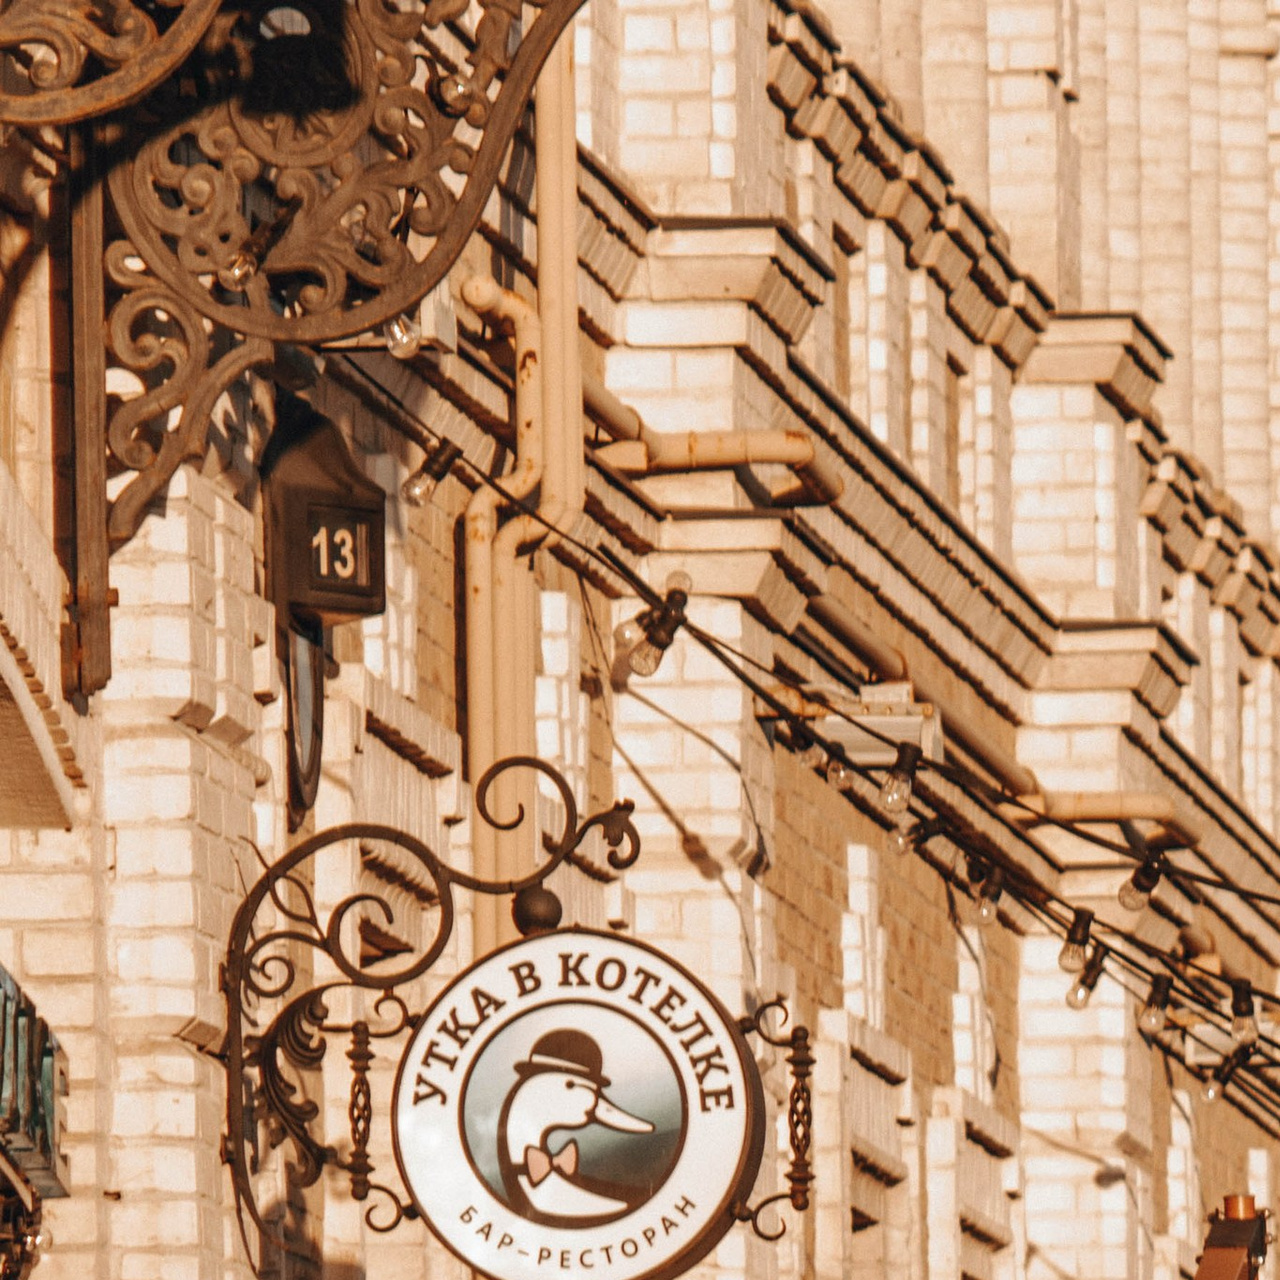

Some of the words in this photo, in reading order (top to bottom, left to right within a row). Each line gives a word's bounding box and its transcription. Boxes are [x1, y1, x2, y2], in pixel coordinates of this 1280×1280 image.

[312, 526, 355, 578] 13
[412, 986, 506, 1106] УТКА
[508, 960, 542, 998] В
[557, 953, 735, 1112] КОТЕЛКЕ
